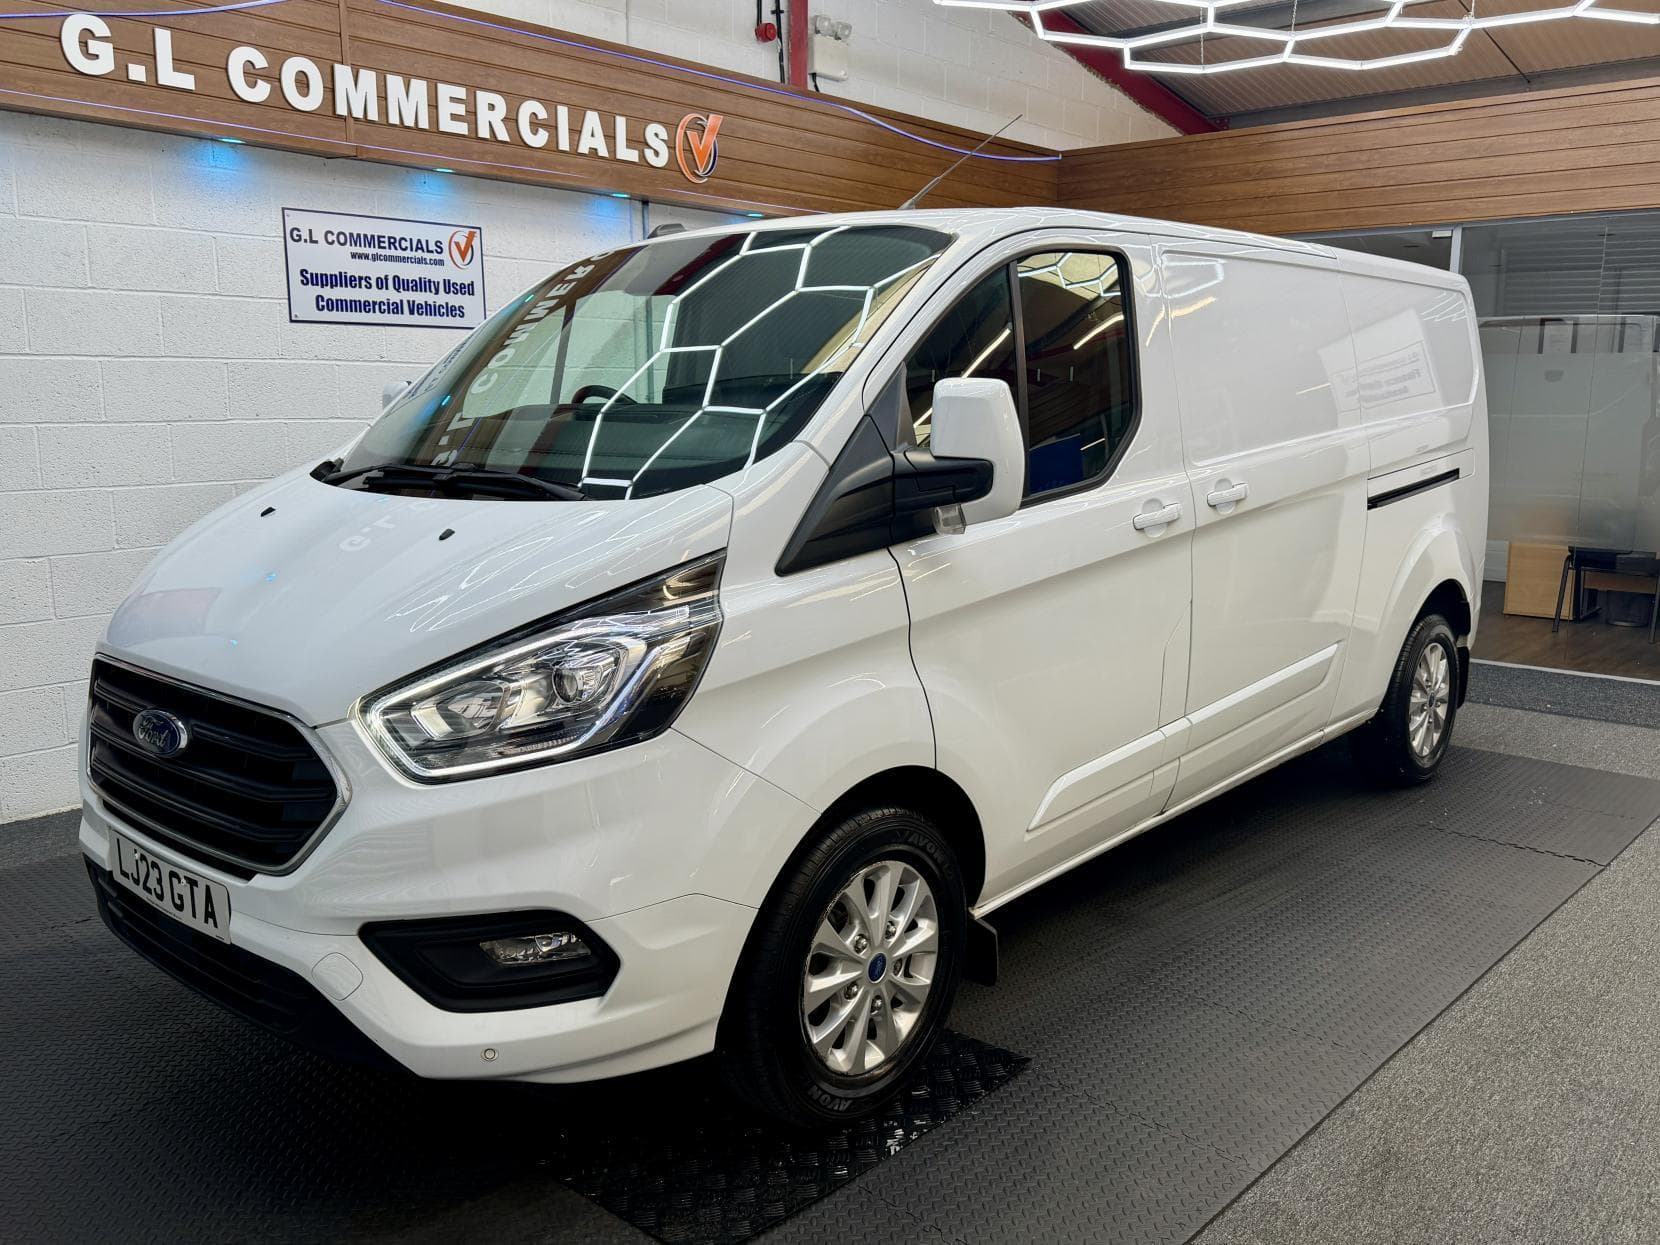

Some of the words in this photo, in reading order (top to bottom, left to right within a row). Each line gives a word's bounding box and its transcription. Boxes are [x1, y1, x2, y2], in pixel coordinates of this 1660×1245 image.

[60, 13, 196, 91] G.L
[227, 46, 669, 169] COMMERCIALS
[289, 227, 318, 244] G.L
[324, 230, 444, 255] COMMERCIALS
[350, 251, 445, 267] www.glcommercials.com
[300, 268, 372, 290] Suppliers
[375, 274, 389, 291] of
[392, 274, 440, 296] Quality
[443, 278, 475, 296] Used
[315, 294, 404, 315] Commercial
[404, 299, 465, 318] Vehicles
[138, 715, 170, 748] Ford
[116, 838, 165, 902] LJ23
[168, 869, 218, 929] GTA
